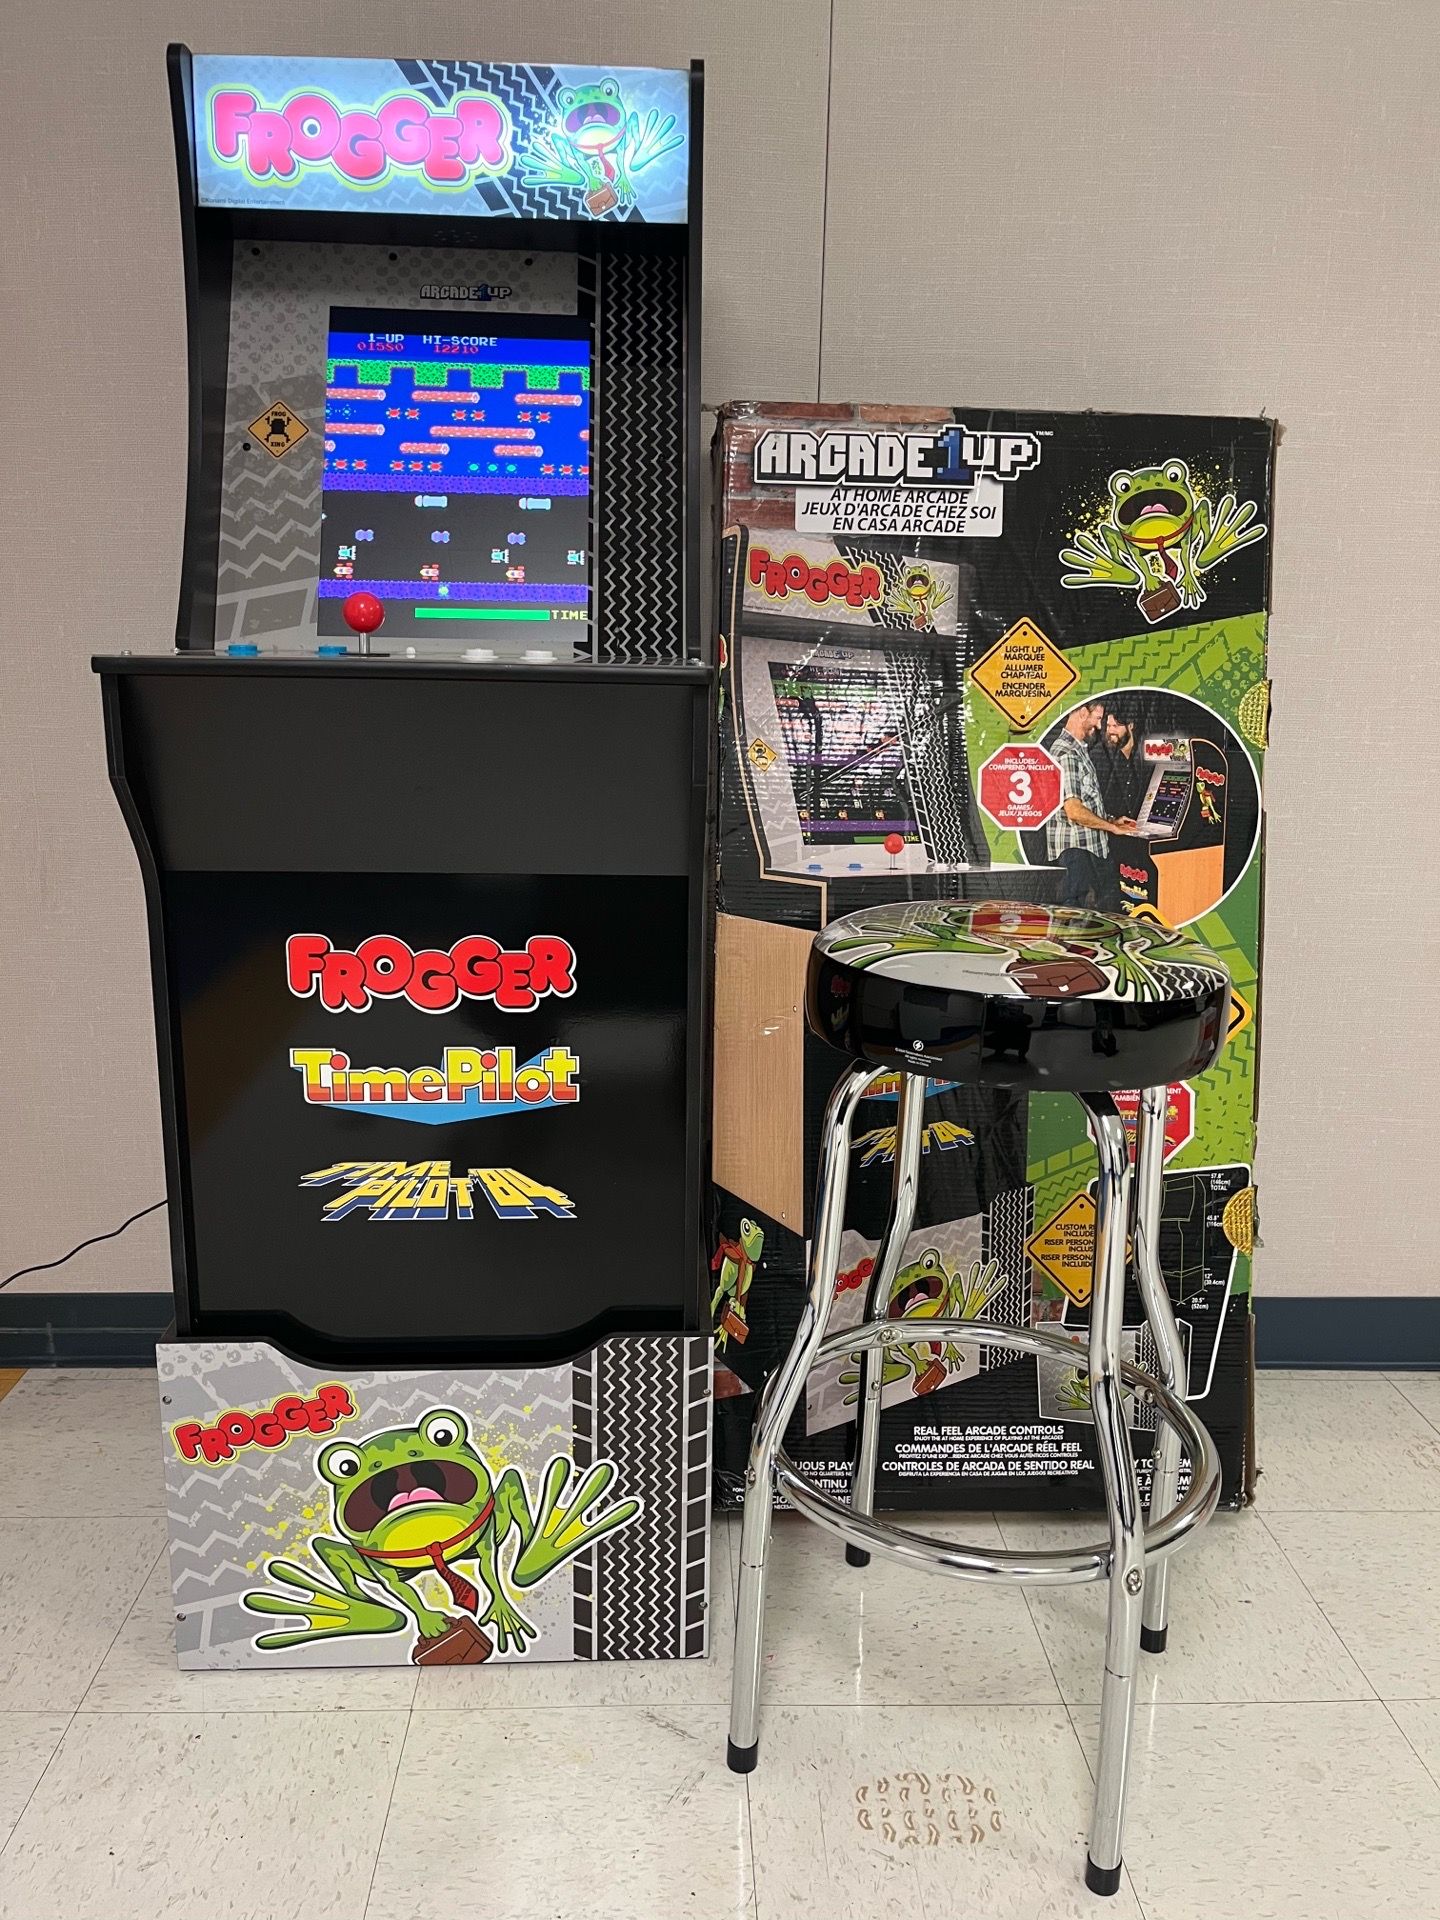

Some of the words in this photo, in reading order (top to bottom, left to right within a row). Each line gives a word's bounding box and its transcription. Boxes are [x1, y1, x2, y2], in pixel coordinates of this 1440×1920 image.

[211, 91, 505, 182] FROGGER
[368, 333, 404, 343] 1-UP
[422, 335, 498, 347] HI-SCORE
[434, 345, 479, 354] 12210
[830, 489, 849, 502] AT
[851, 489, 900, 503] HOME
[901, 490, 969, 504] ARCADE
[801, 502, 844, 516] JEUX
[846, 502, 922, 518] D'ARCADE
[925, 505, 967, 519] CHEZ
[969, 506, 997, 520] SOI
[832, 517, 854, 531] EN
[856, 518, 899, 532] CASA
[900, 519, 966, 533] ARCADE
[750, 549, 882, 607] FROGGER
[551, 610, 589, 620] TIME
[1003, 653, 1046, 661] MARQUEE
[1031, 646, 1044, 654] UP
[1001, 682, 1046, 690] ENCENDER
[994, 690, 1052, 698] MARQUESINA
[1008, 770, 1033, 805] 3
[286, 934, 577, 1014] FROGGER
[299, 1161, 451, 1187] TIME
[320, 1177, 473, 1221] PILOT
[173, 1384, 356, 1465] FROGGER
[913, 1426, 939, 1436] REAL
[941, 1426, 963, 1435] FEEL
[965, 1426, 1007, 1435] ARCADE
[1009, 1425, 1064, 1435] CONTROLS
[895, 1444, 966, 1453] COMMANDES
[968, 1444, 982, 1453] DE
[984, 1443, 1034, 1453] L'ARCADE
[1036, 1441, 1059, 1452] RÉEL
[1061, 1443, 1082, 1452] FEEL
[792, 1461, 826, 1470] UOUS
[828, 1461, 854, 1470] PLAY
[882, 1461, 943, 1471] CONTROLES
[946, 1461, 960, 1471] DE
[961, 1461, 1006, 1470] ARCADA
[1008, 1461, 1021, 1470] DE
[1024, 1460, 1068, 1470] SENTIDO
[1070, 1460, 1094, 1469] REAL
